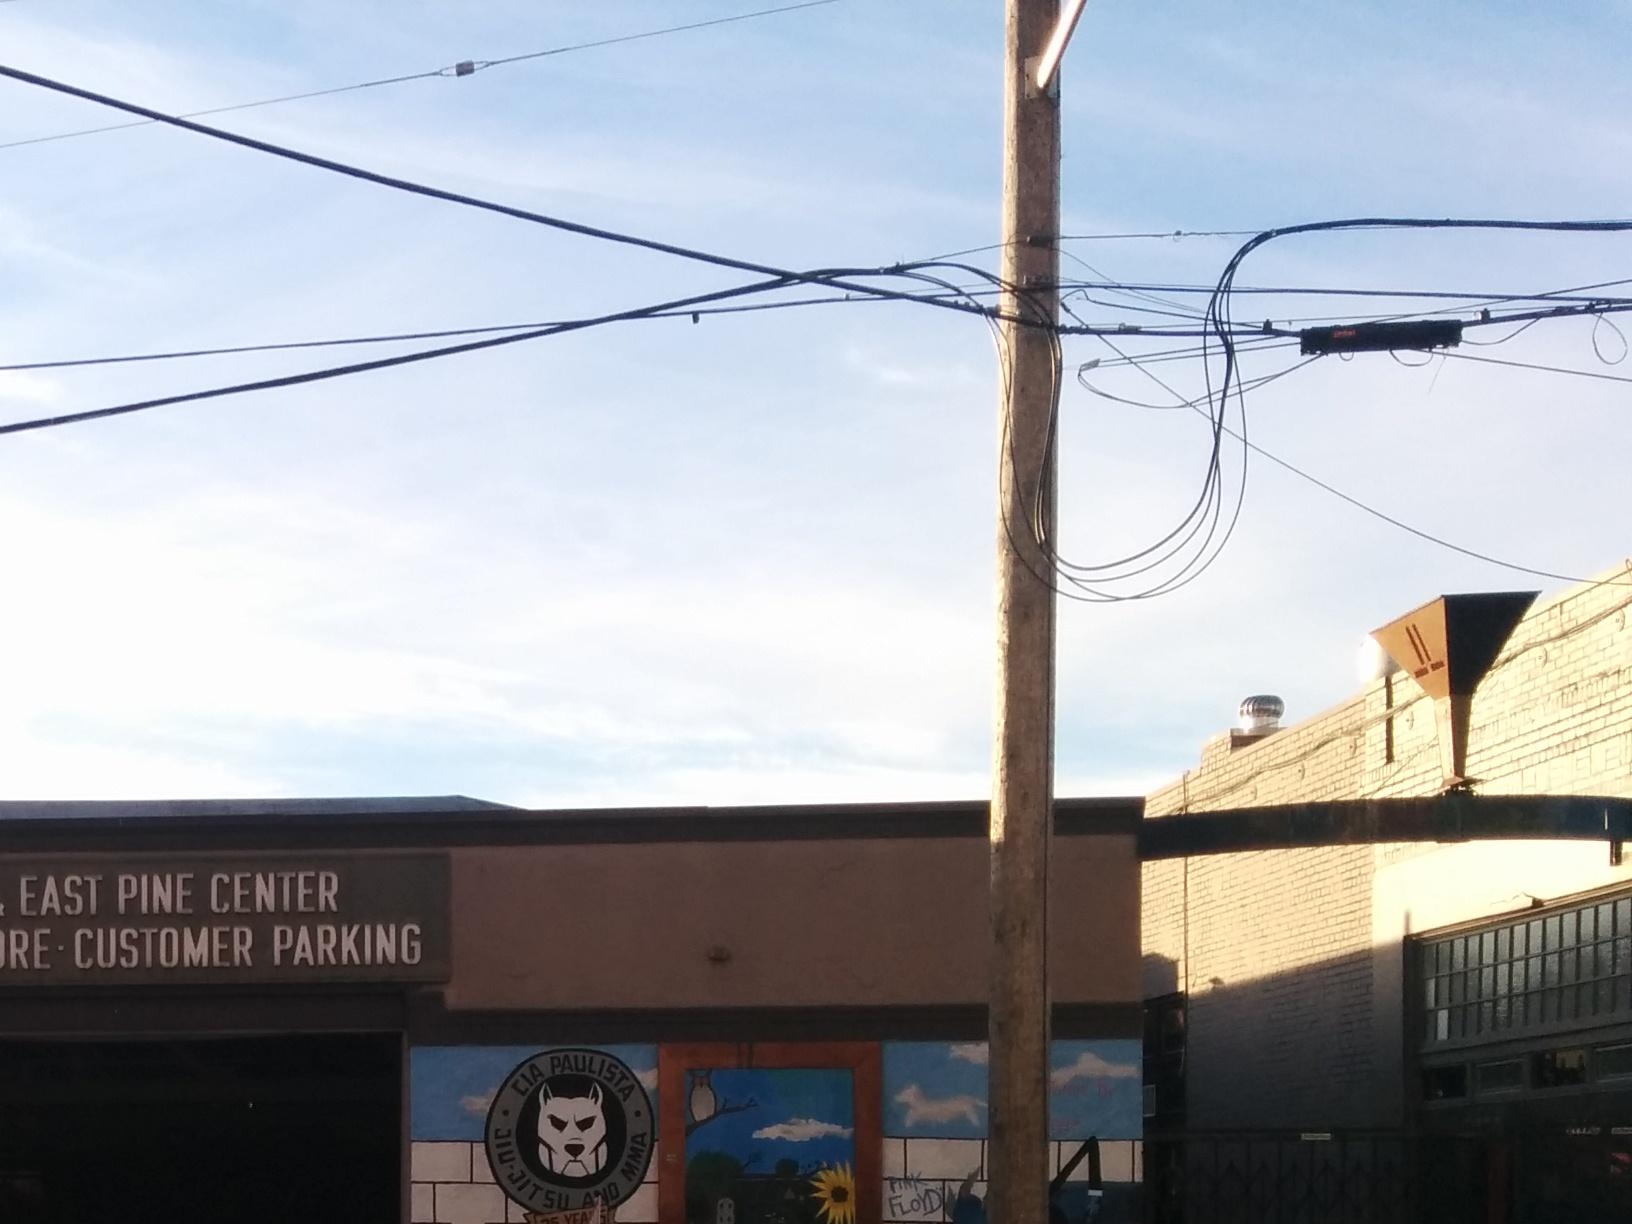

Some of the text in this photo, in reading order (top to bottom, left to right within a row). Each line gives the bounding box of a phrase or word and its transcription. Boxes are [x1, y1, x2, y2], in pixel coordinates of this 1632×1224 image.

[20, 874, 103, 917] EAST
[118, 873, 194, 915] PINE
[210, 871, 339, 914] CENTER
[74, 927, 253, 971] CUSTOMER
[273, 924, 422, 967] PARKING
[550, 1053, 637, 1102] PAULISTA
[620, 1131, 648, 1183] MMA
